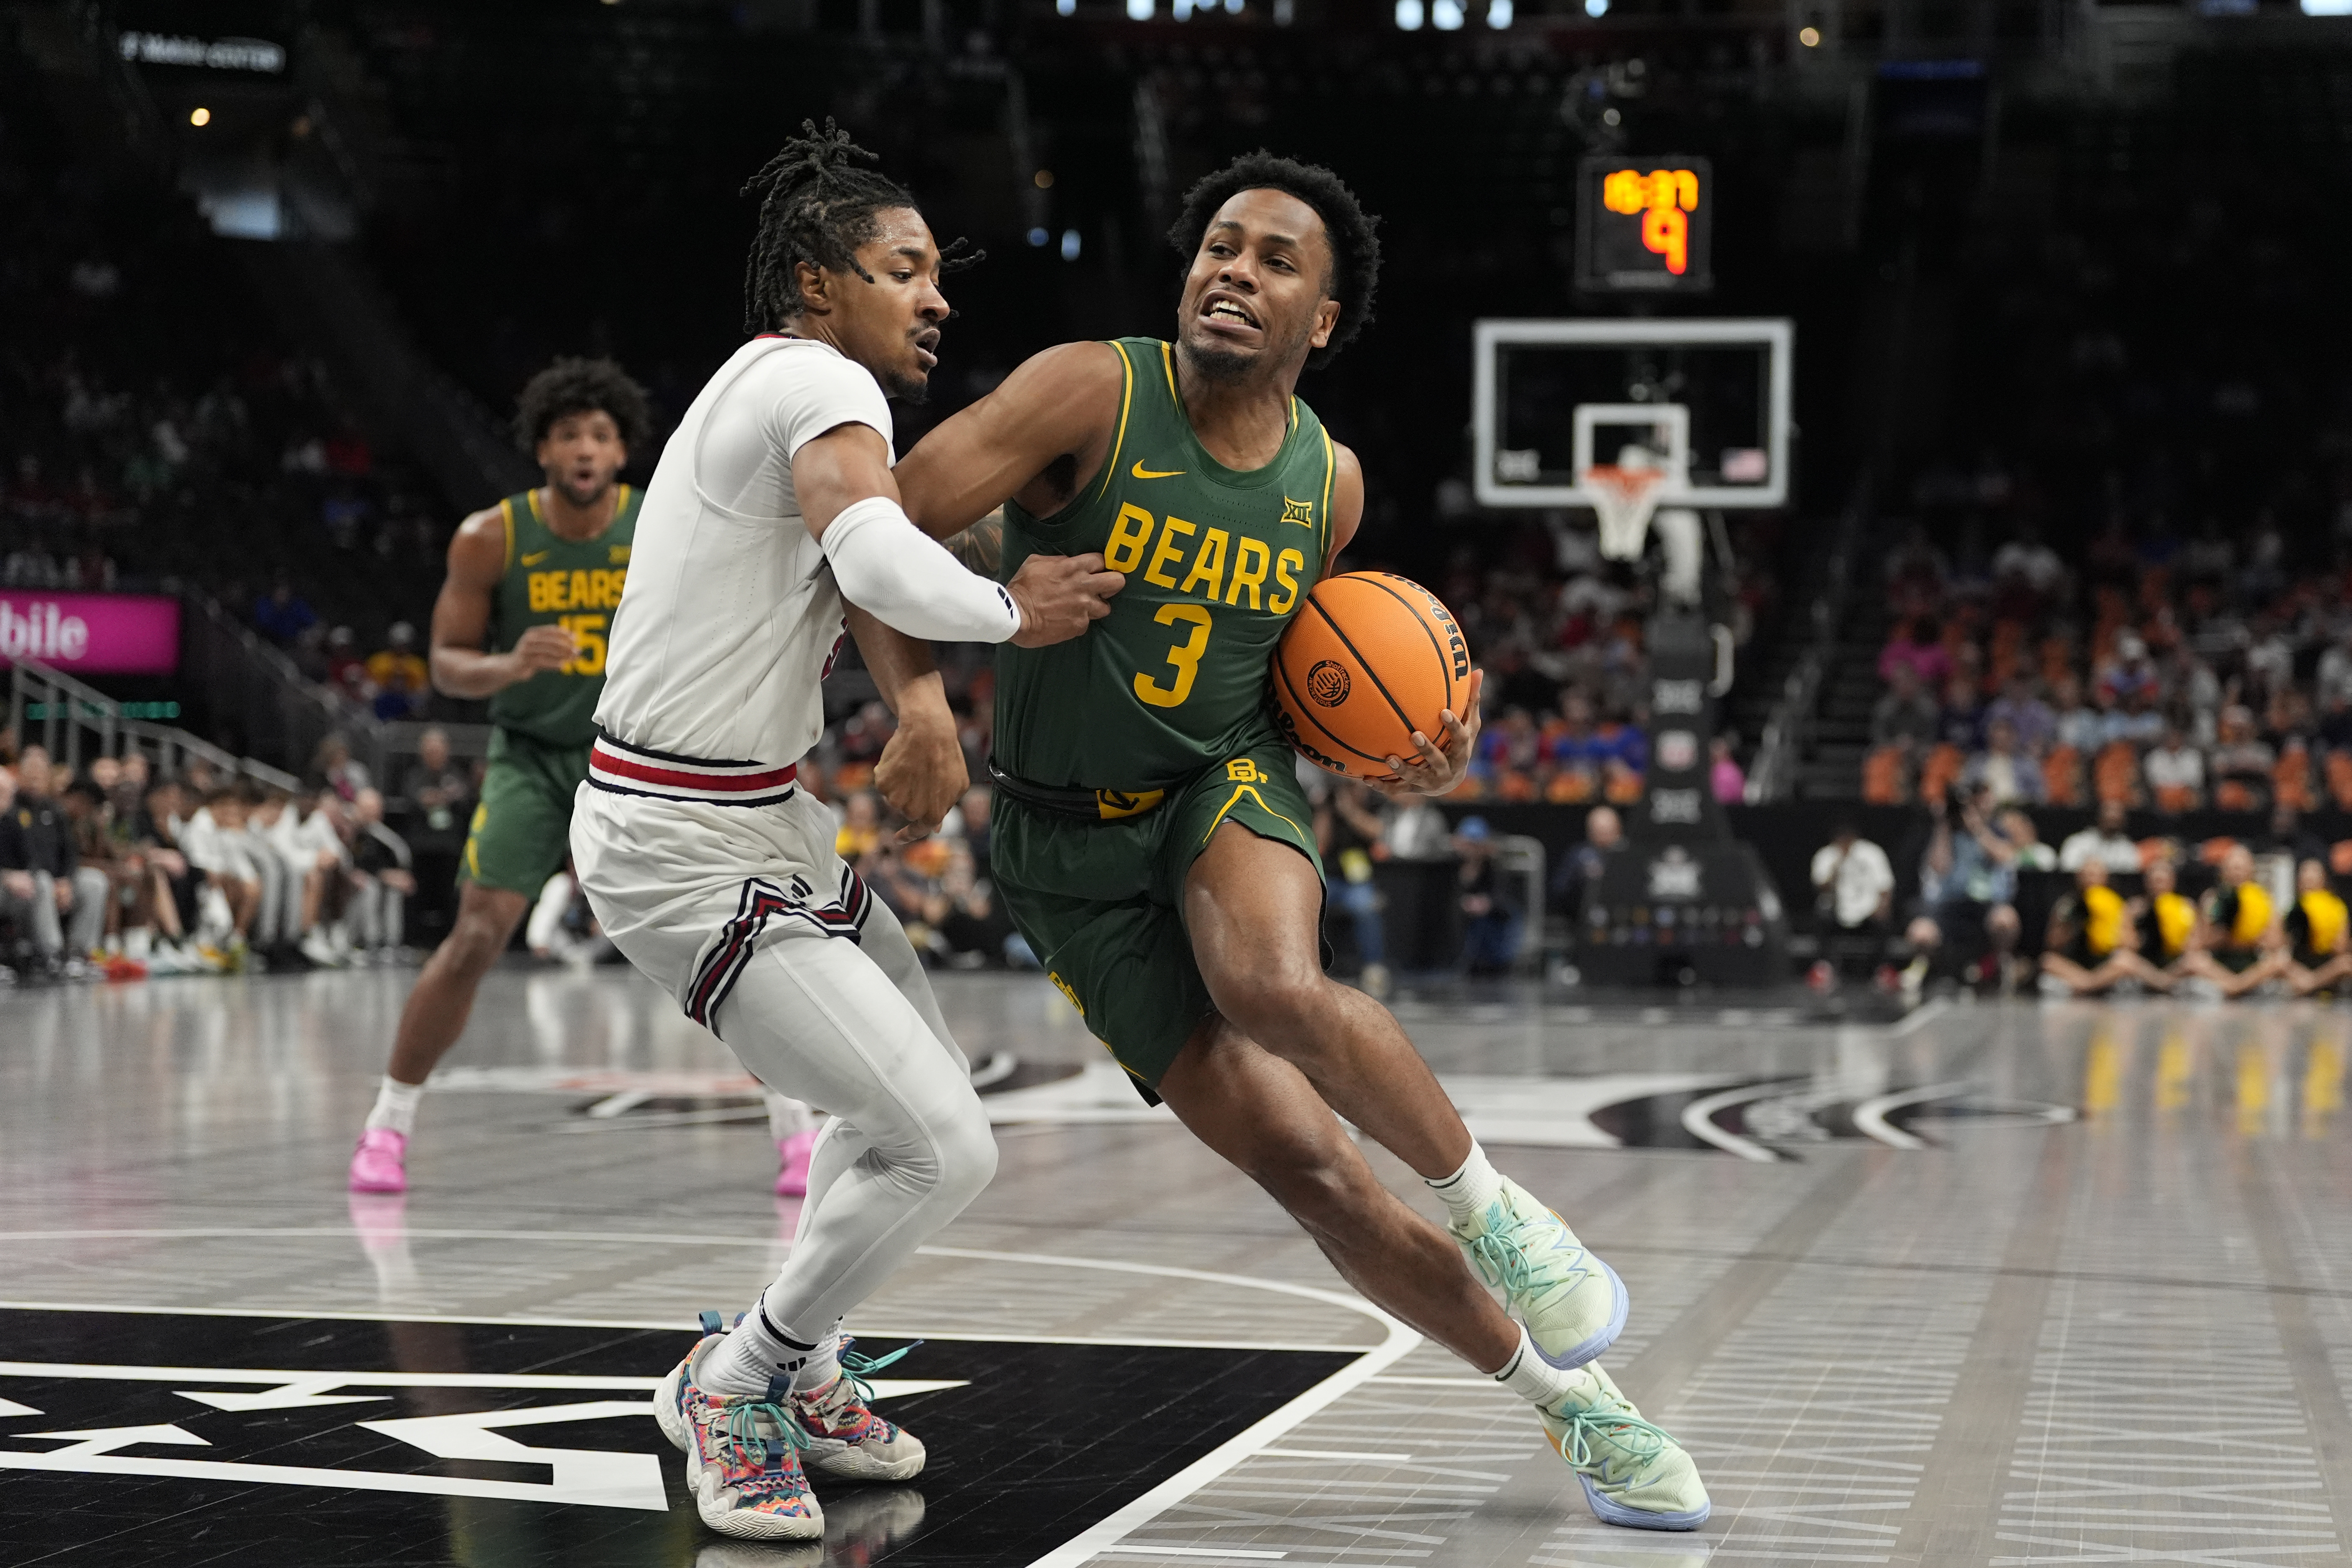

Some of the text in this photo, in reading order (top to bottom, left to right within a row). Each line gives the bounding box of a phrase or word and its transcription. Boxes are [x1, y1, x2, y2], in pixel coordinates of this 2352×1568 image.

[1642, 208, 1688, 275] 9
[1104, 501, 1304, 615] BEARS
[527, 568, 627, 612] BEARS
[1133, 603, 1212, 708] 3
[1326, 660, 1350, 692] ShotTracker
[1308, 676, 1332, 707] ShotTracker
